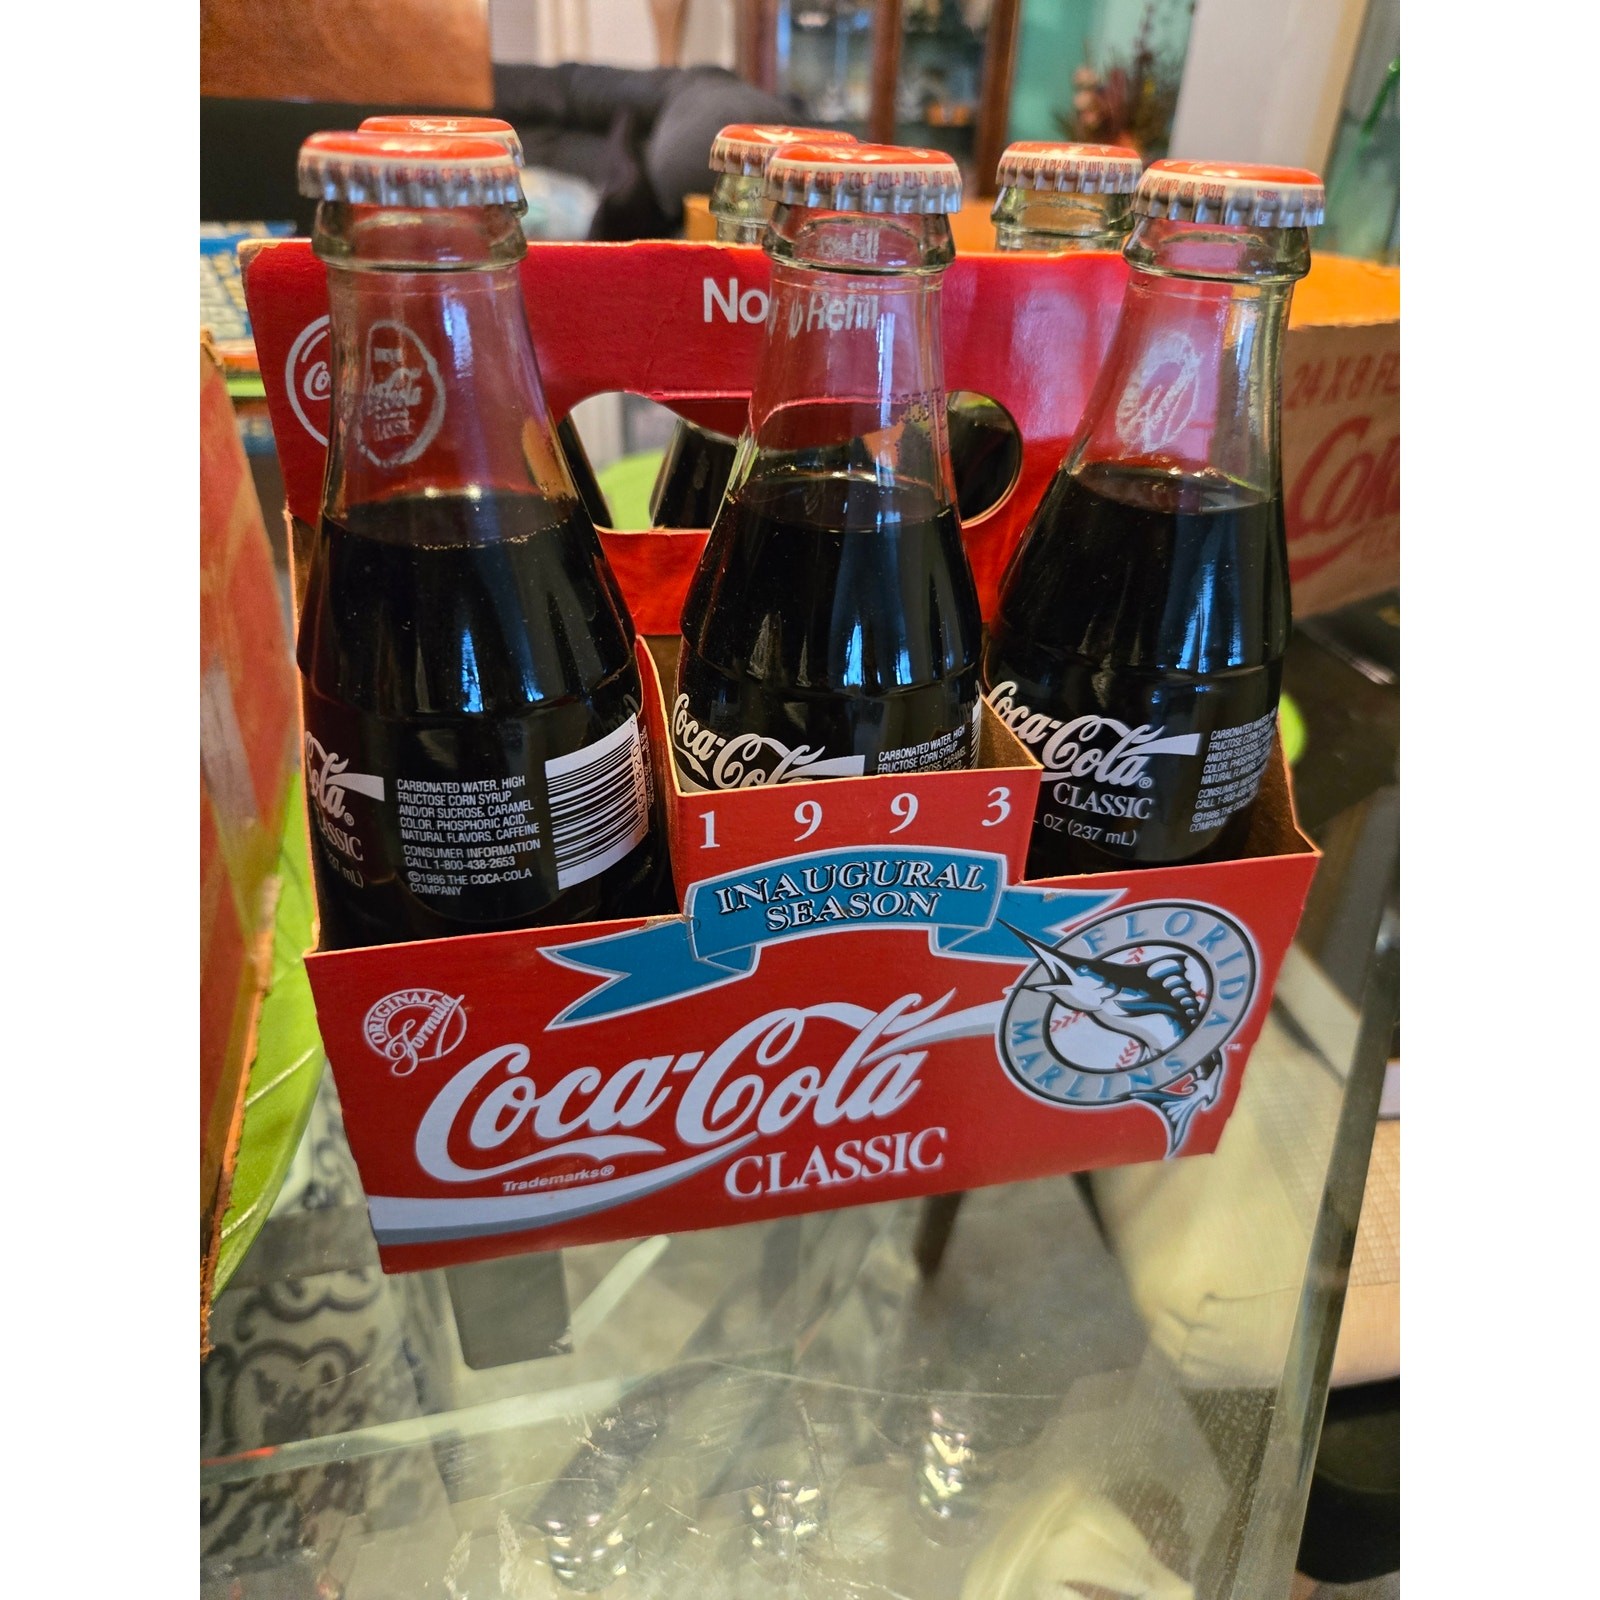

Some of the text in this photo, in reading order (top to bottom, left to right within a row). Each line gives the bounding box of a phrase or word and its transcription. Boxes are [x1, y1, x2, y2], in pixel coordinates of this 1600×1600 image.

[703, 277, 769, 324] No
[877, 740, 958, 775] FRUCTOSE CORN SYRUP
[878, 742, 930, 762] CARBONATED
[397, 778, 460, 794] CARBONATED
[501, 775, 526, 790] HIGH
[398, 790, 512, 807] FRUCTOSE CORN SYRUP
[399, 804, 435, 818] AND/OR
[488, 799, 535, 817] CARAMEL
[1053, 782, 1153, 820] CLASSIC
[1195, 799, 1215, 810] CALL
[401, 828, 446, 843] NATURAL
[496, 822, 540, 841] CAFFEINE
[437, 818, 501, 832] PHOSPHORIC
[1043, 813, 1137, 847] OZ (237 mL)
[1189, 816, 1228, 832] COMPANY
[403, 838, 541, 859] CONSUMER INFORMATION
[405, 855, 516, 871] CALL 1-800-438-2653
[447, 874, 469, 885] THE
[470, 868, 533, 885] COCA-COLA
[410, 882, 462, 897] COMPANY
[713, 859, 987, 916] INAUGURAL
[766, 890, 942, 933] SEASON
[1081, 910, 1248, 1029] FLORIDA
[368, 991, 435, 1044] ORIGINAL
[385, 993, 464, 1077] Formula
[1011, 1017, 1188, 1099] MARLINS
[415, 989, 956, 1182] Coca-Cola
[725, 1126, 948, 1198] CLASSIC
